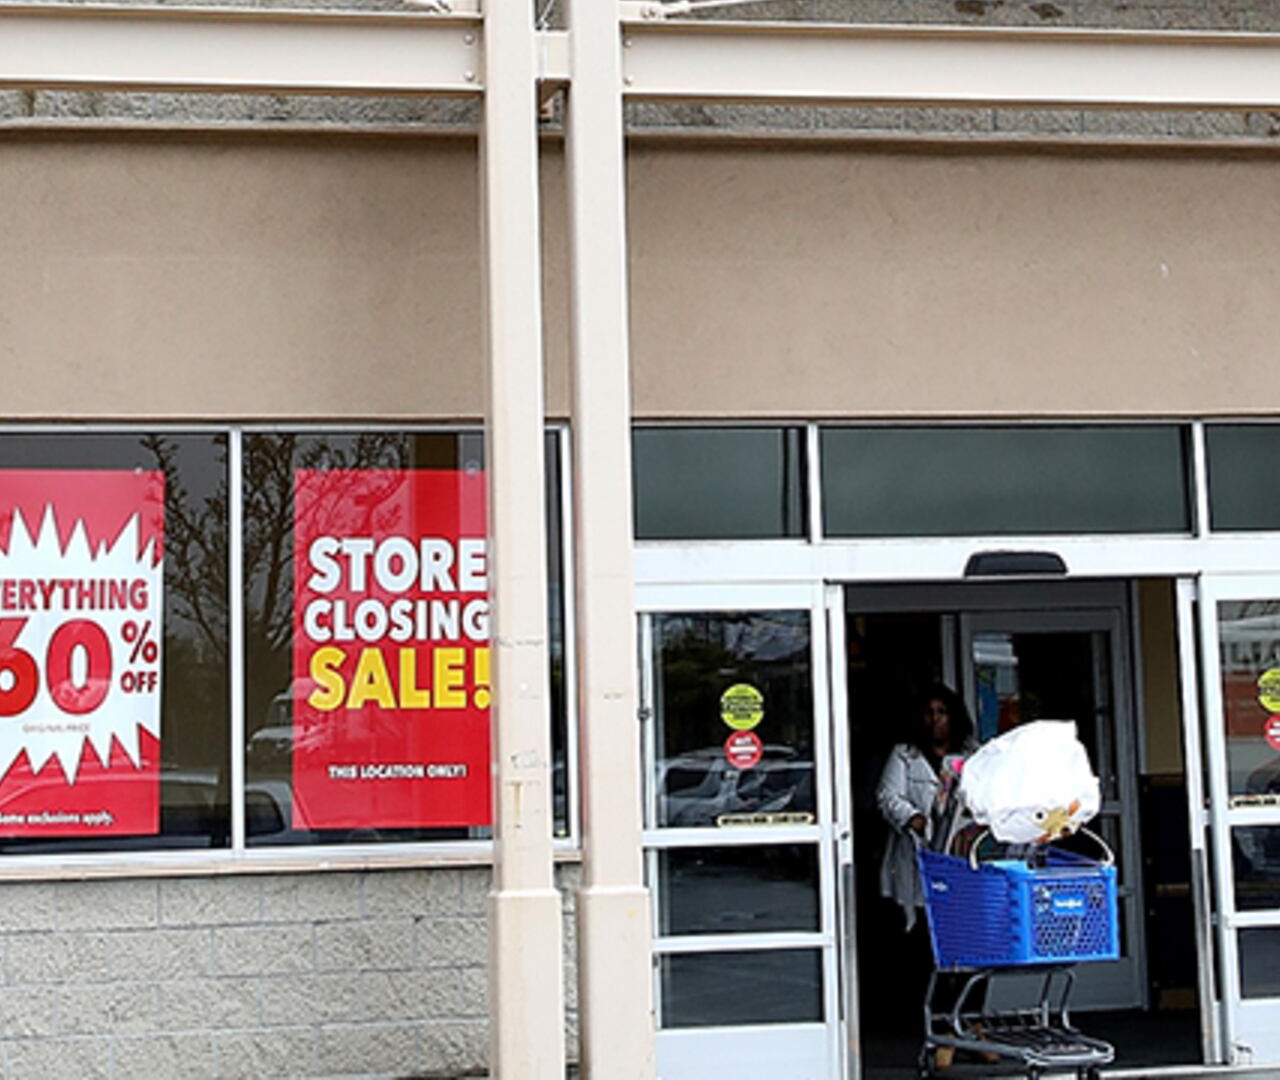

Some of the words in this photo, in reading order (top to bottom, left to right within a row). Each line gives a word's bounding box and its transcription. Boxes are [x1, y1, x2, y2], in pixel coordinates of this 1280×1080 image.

[308, 536, 488, 593] STORE
[304, 598, 490, 642] CLOSING
[120, 671, 158, 694] OFF
[307, 646, 491, 712] SALE!
